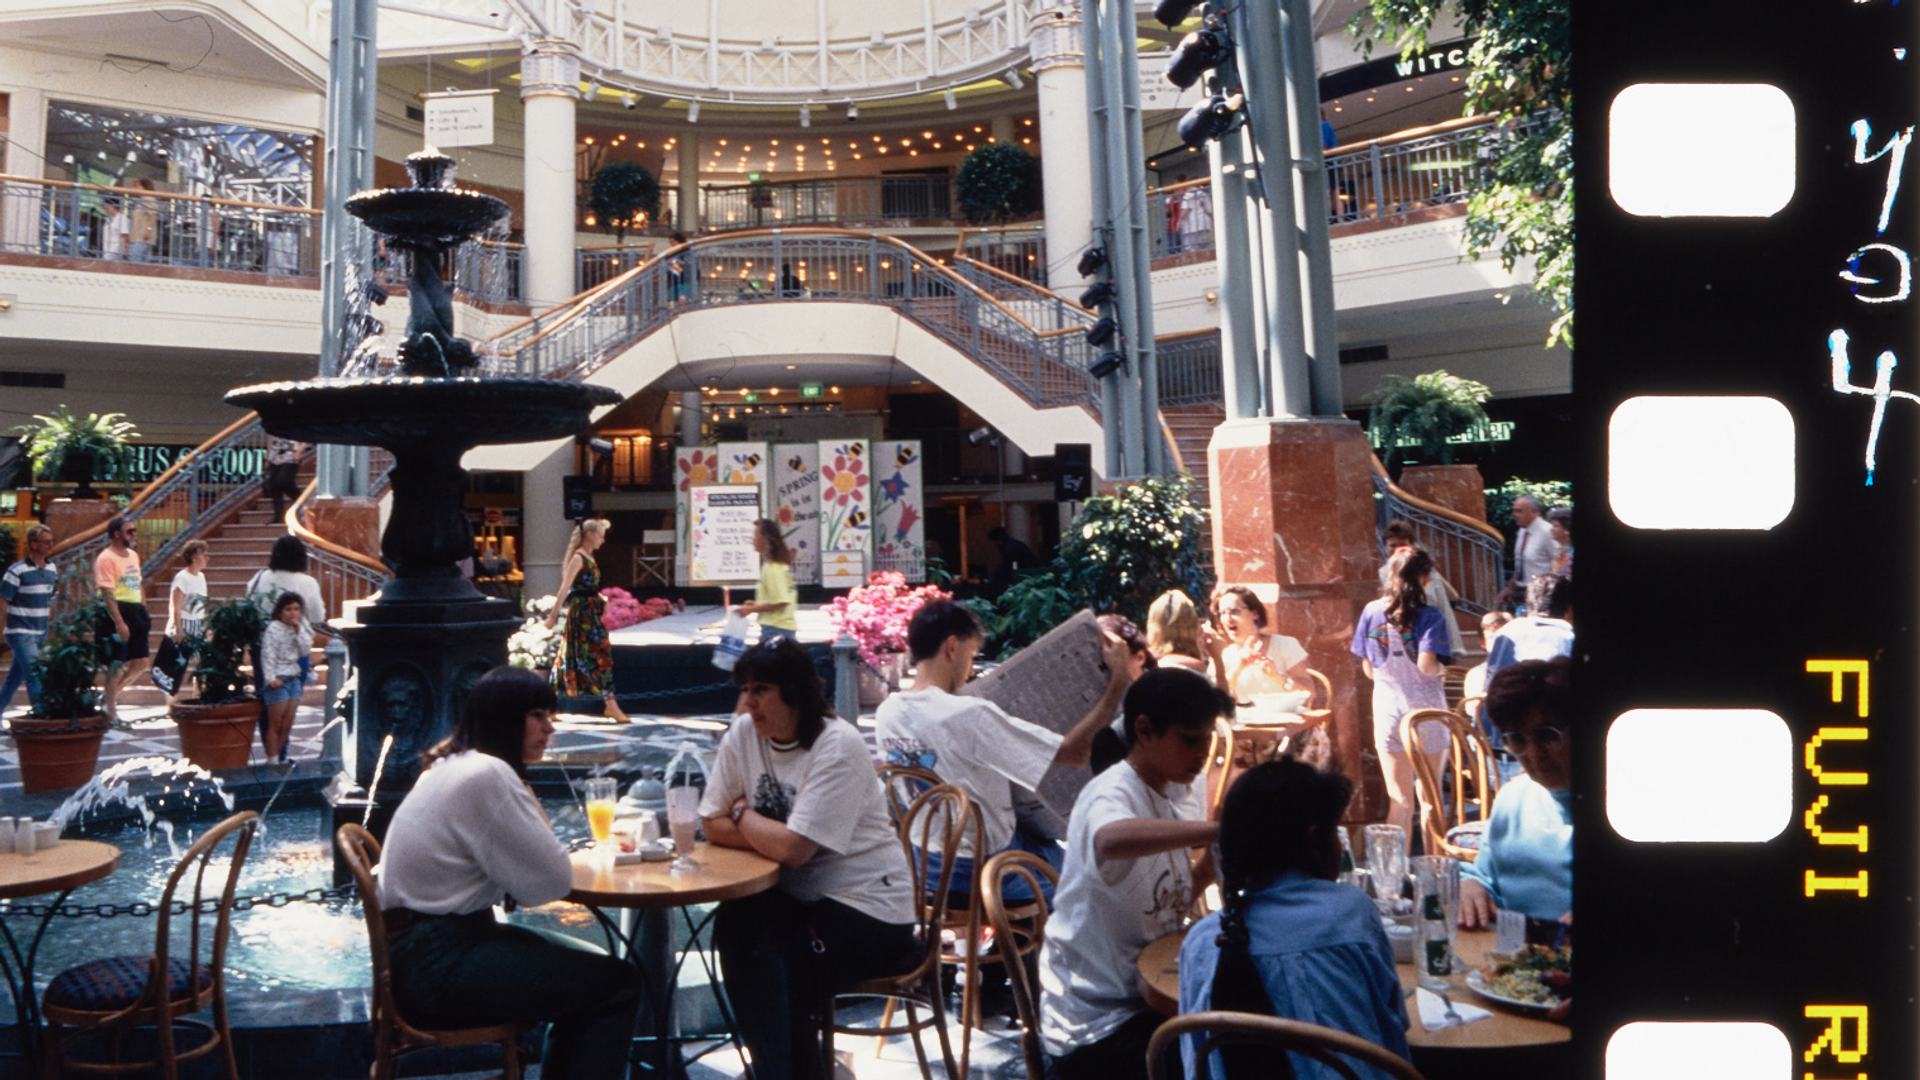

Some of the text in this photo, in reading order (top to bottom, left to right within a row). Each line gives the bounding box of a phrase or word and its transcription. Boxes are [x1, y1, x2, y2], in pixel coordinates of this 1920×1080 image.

[1395, 49, 1465, 77] WITC
[207, 448, 267, 474] COOT
[779, 470, 819, 497] SPRING
[1805, 659, 1869, 898] FUJI
[1804, 1005, 1868, 1080] R
